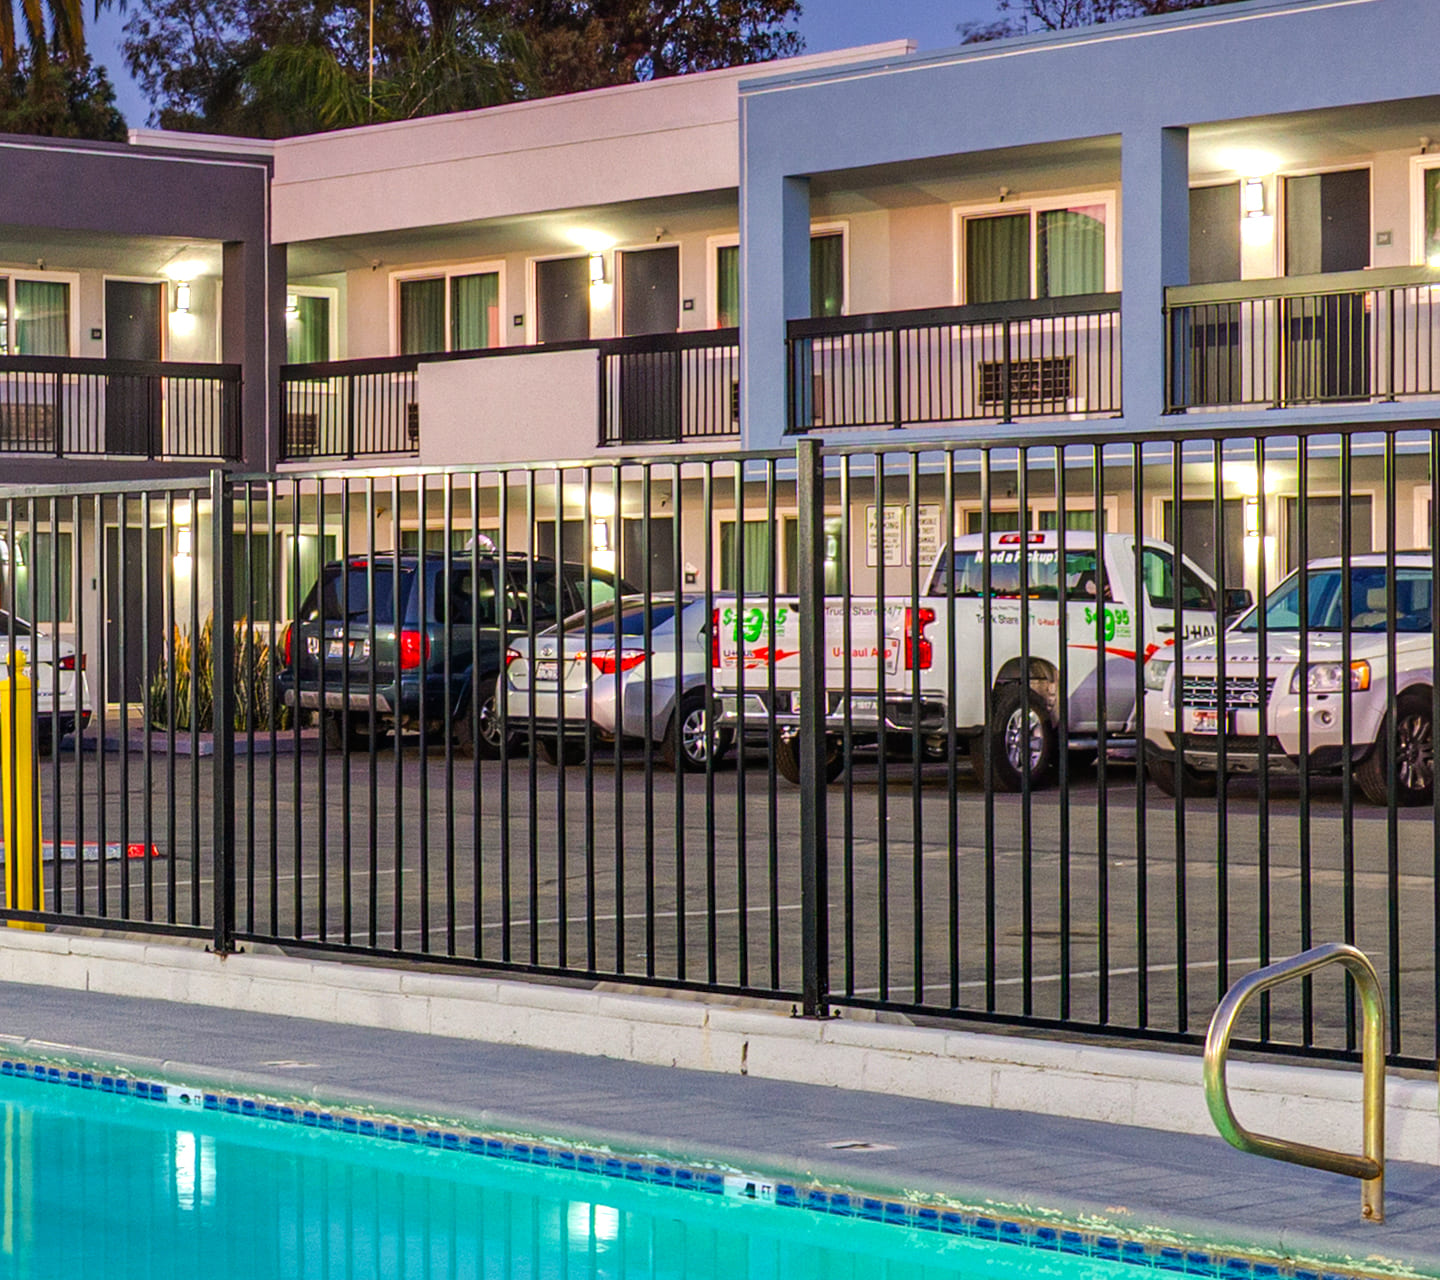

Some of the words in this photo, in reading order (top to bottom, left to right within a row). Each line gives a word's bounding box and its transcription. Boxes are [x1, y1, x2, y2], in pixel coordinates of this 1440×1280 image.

[1005, 553, 1014, 564] a
[825, 607, 845, 617] Truc
[832, 648, 868, 657] U-aul
[871, 648, 892, 659] Ap
